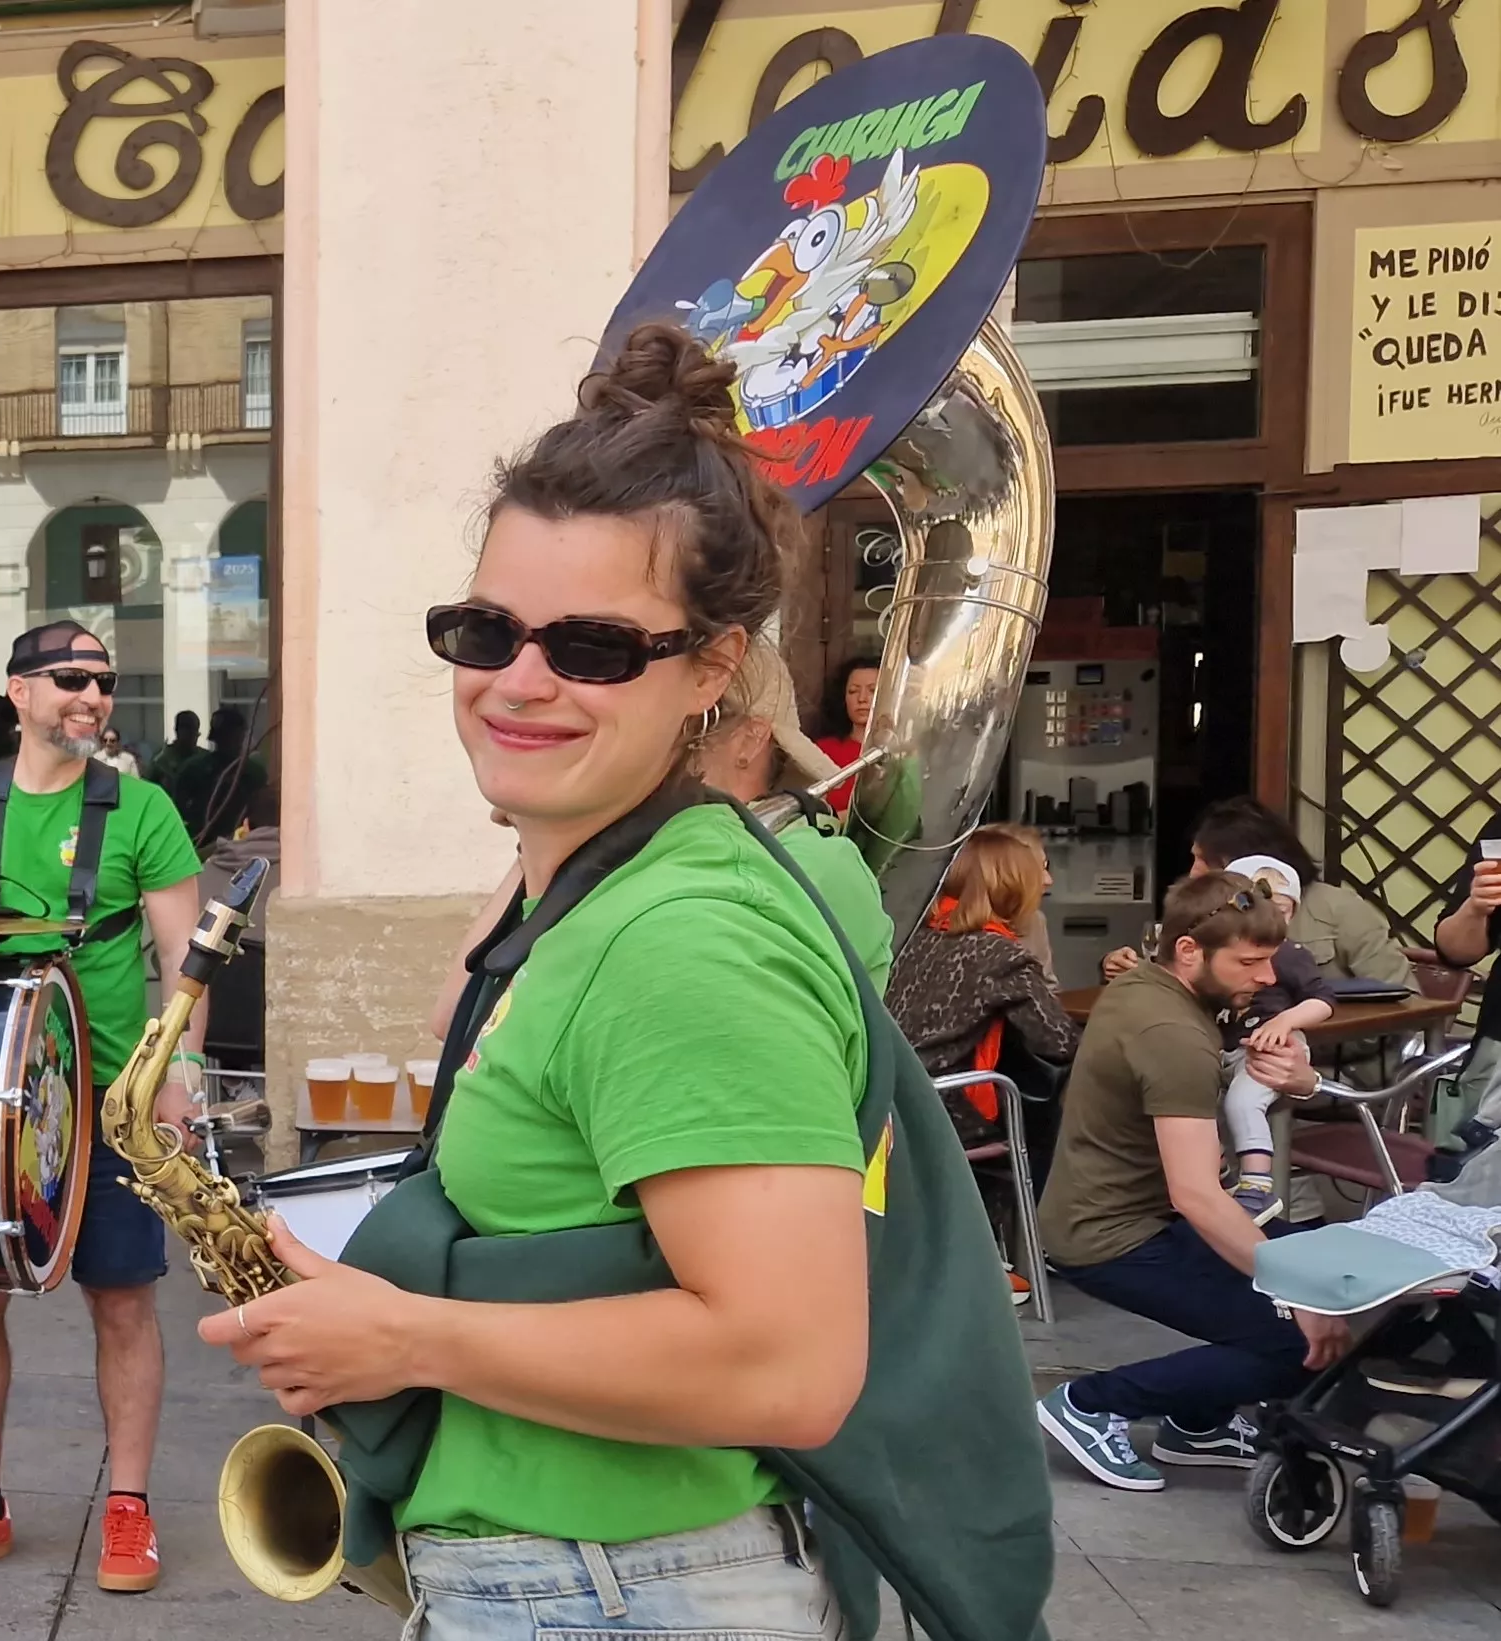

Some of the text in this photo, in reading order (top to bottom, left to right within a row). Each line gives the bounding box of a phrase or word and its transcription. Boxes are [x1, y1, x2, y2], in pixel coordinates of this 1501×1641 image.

[773, 80, 986, 182] CHARANGA
[1369, 235, 1491, 279] ME PIDIÓ
[1371, 294, 1391, 322] Y
[1408, 292, 1437, 320] LE
[1378, 384, 1431, 417] ¡FUE
[223, 563, 255, 576] 2025
